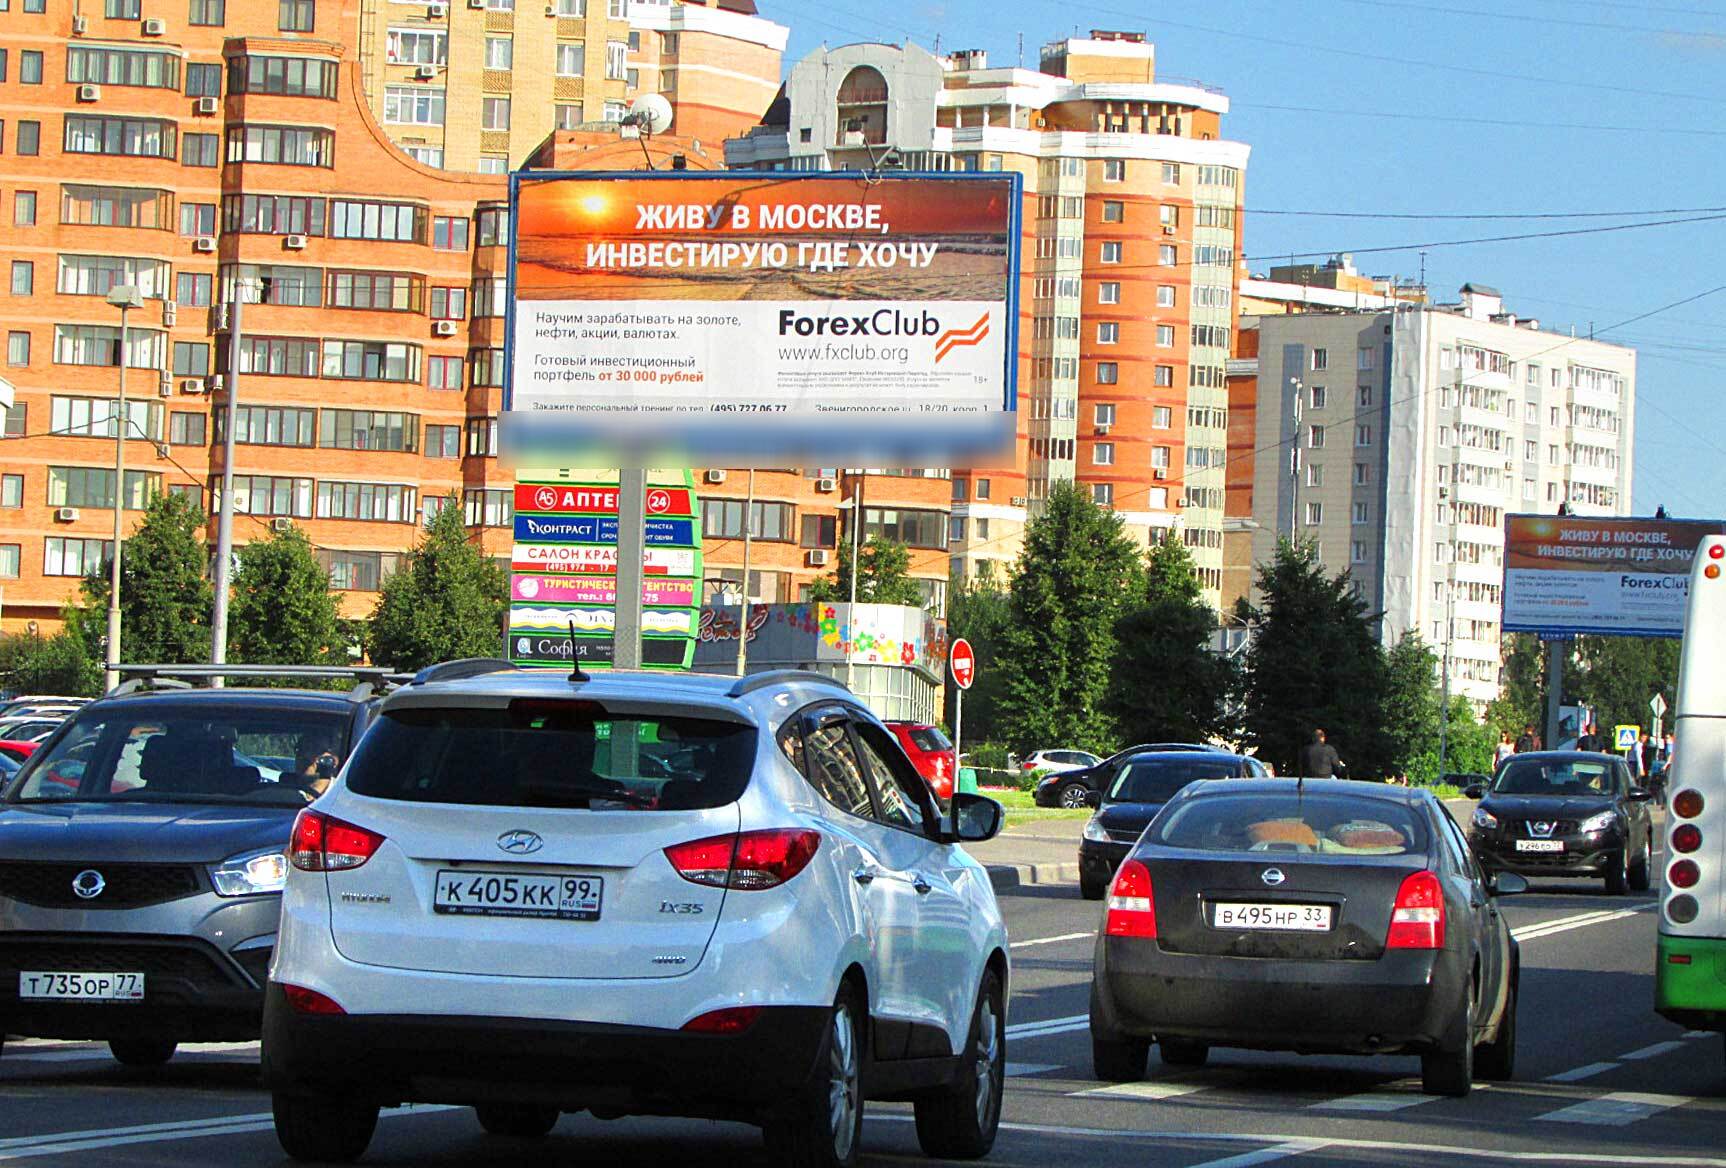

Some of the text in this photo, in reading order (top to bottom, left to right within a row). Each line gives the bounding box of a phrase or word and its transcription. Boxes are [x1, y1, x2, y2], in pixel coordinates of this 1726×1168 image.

[635, 203, 890, 234] ЖИВУ В МОСКВЕ,
[586, 242, 939, 272] ИНВЕСТИРУЮ ГДЕ ХОЧУ
[536, 312, 741, 327] Научим зарабатывать на золоте,
[778, 309, 941, 336] ForexClub
[535, 327, 680, 341] нефти, акции, валютах.
[534, 353, 696, 368] Готовый инвестиционный
[778, 343, 909, 363] www.fxclub.org
[533, 369, 704, 384] портфель от 30 000 рублей
[533, 402, 576, 411] Закажите
[576, 403, 639, 412] персональный
[650, 496, 667, 507] 24
[537, 524, 592, 535] КОНТРАСТ
[1559, 529, 1672, 544] ЖИВУ В МОСКВЕ,
[528, 548, 579, 559] САЛОН
[1537, 545, 1694, 561] ИНВЕСТИРУЮ ГДЕ ХОЧУ
[543, 578, 616, 590] ТУРИСТИЧЕСК
[564, 879, 591, 900] 99
[562, 900, 581, 908] RUS
[1304, 908, 1322, 921] 33
[116, 974, 137, 990] 77
